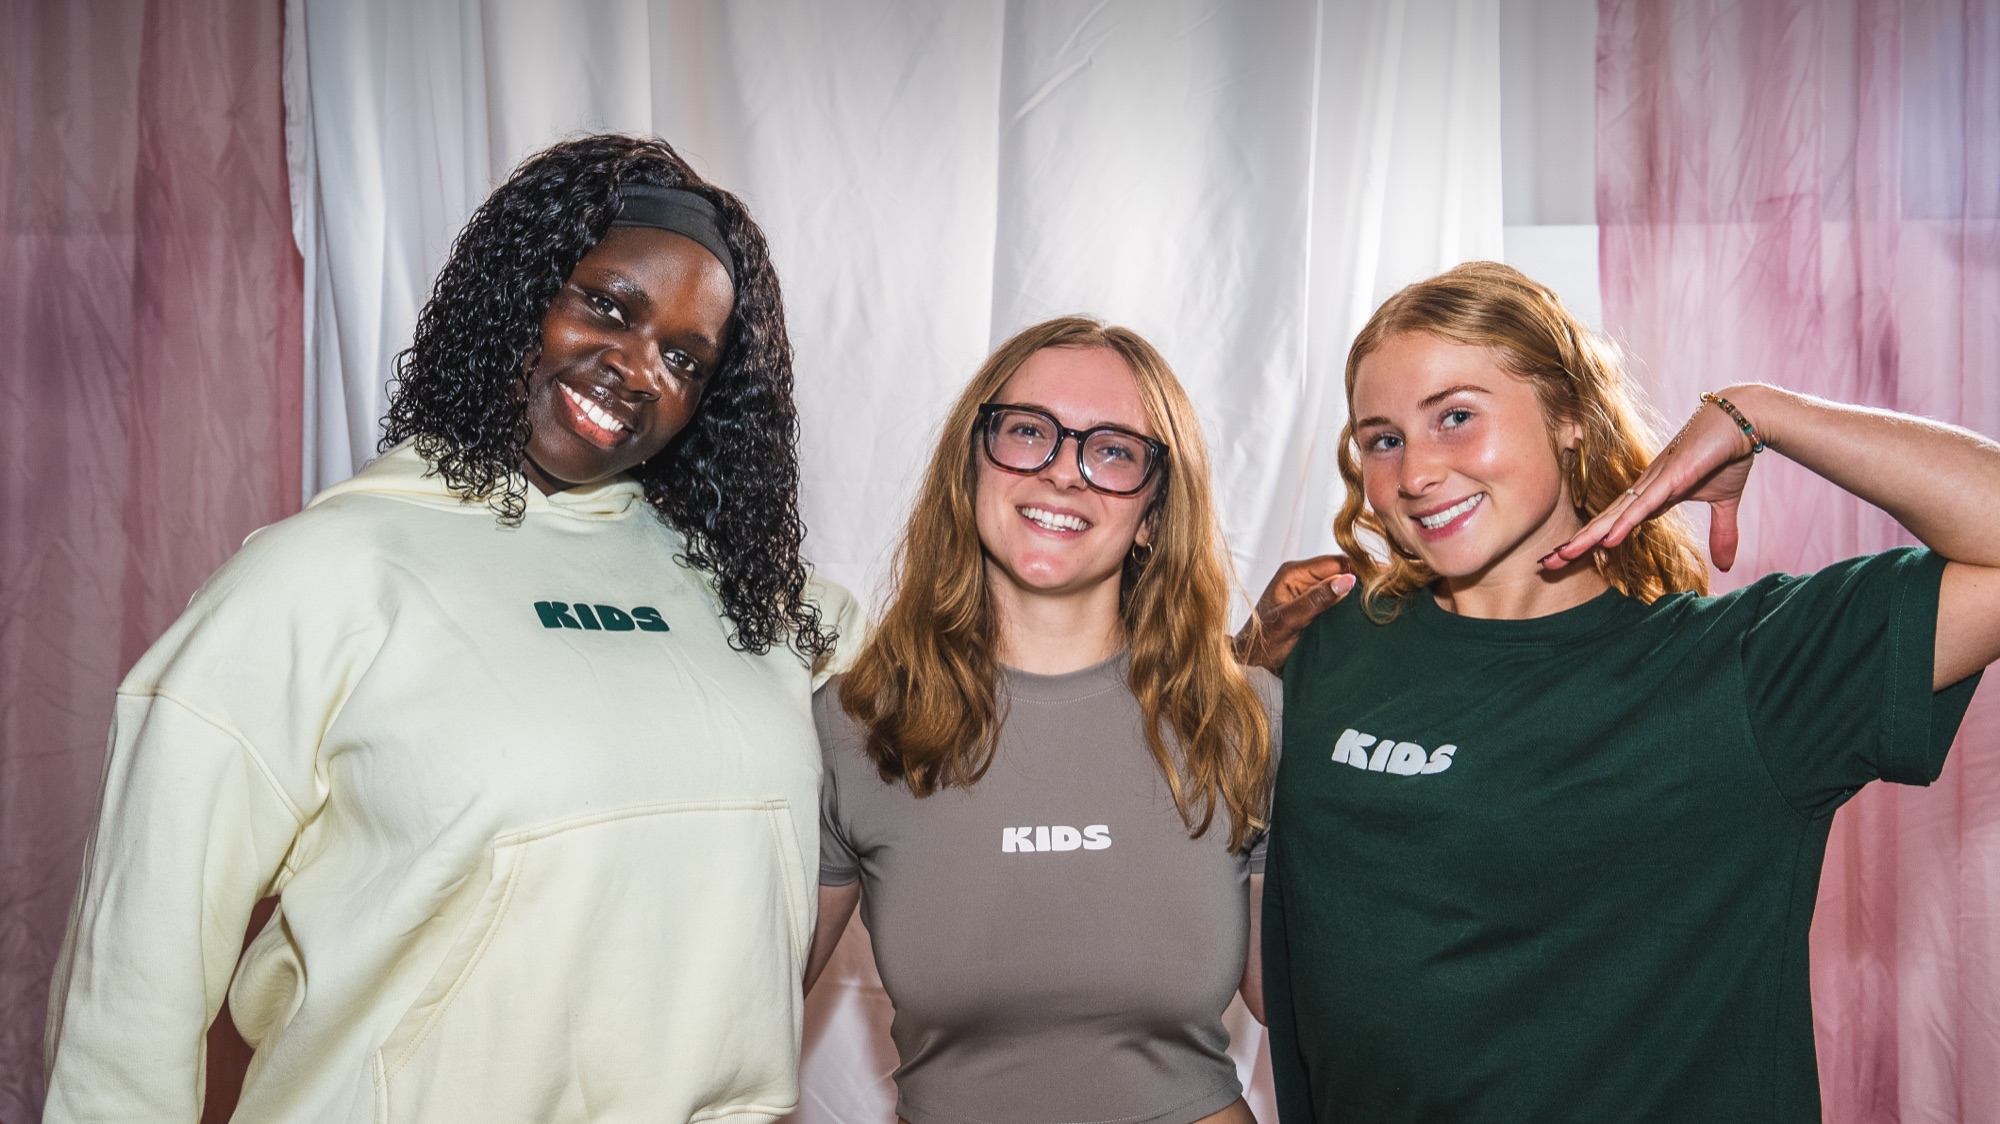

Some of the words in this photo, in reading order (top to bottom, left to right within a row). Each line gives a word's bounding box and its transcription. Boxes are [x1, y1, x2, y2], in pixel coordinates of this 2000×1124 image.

[533, 601, 670, 632] KIDS
[1331, 728, 1458, 776] KIDS
[1001, 824, 1112, 853] KIDS
